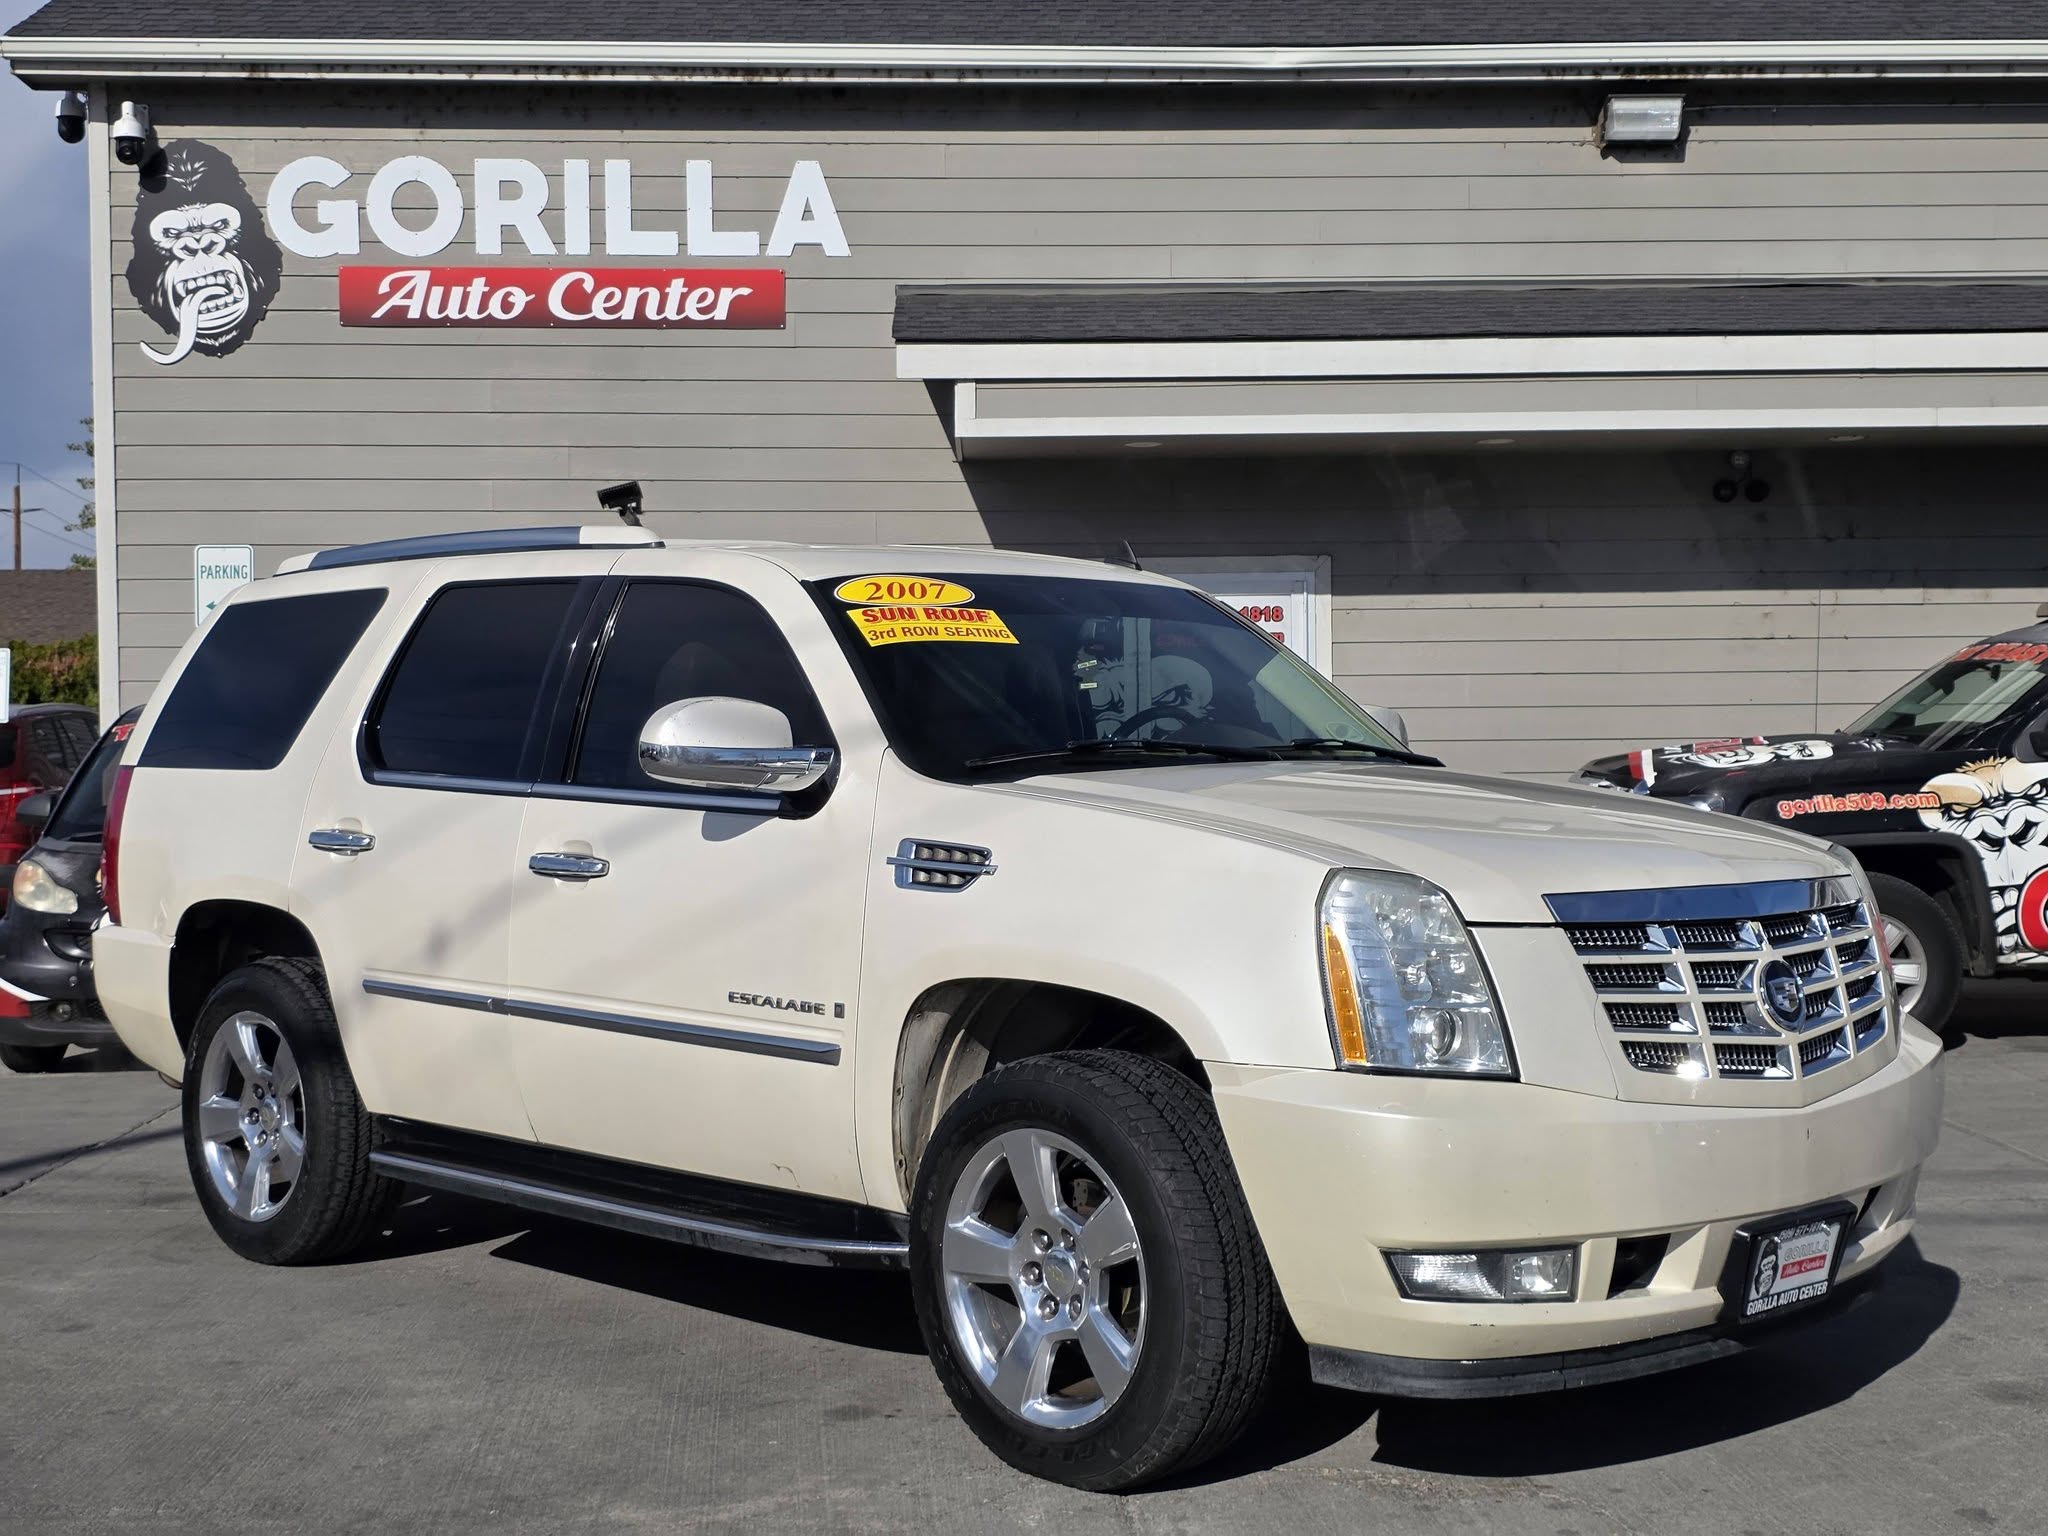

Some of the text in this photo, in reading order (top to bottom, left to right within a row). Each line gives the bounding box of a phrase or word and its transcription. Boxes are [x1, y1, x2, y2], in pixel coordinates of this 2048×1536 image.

[266, 155, 852, 258] GORILLA
[370, 269, 753, 322] Auto Center
[200, 564, 249, 580] PARKING
[863, 581, 947, 601] 2007
[861, 606, 994, 624] SUN ROOF
[868, 626, 1011, 642] 3rd ROW SEATING
[1777, 791, 1941, 819] gorilla509.com
[728, 991, 826, 1016] ESCALADE
[1784, 1239, 1830, 1262] GORILLA
[1746, 1281, 1828, 1315] GORILLA AUTO CENTER
